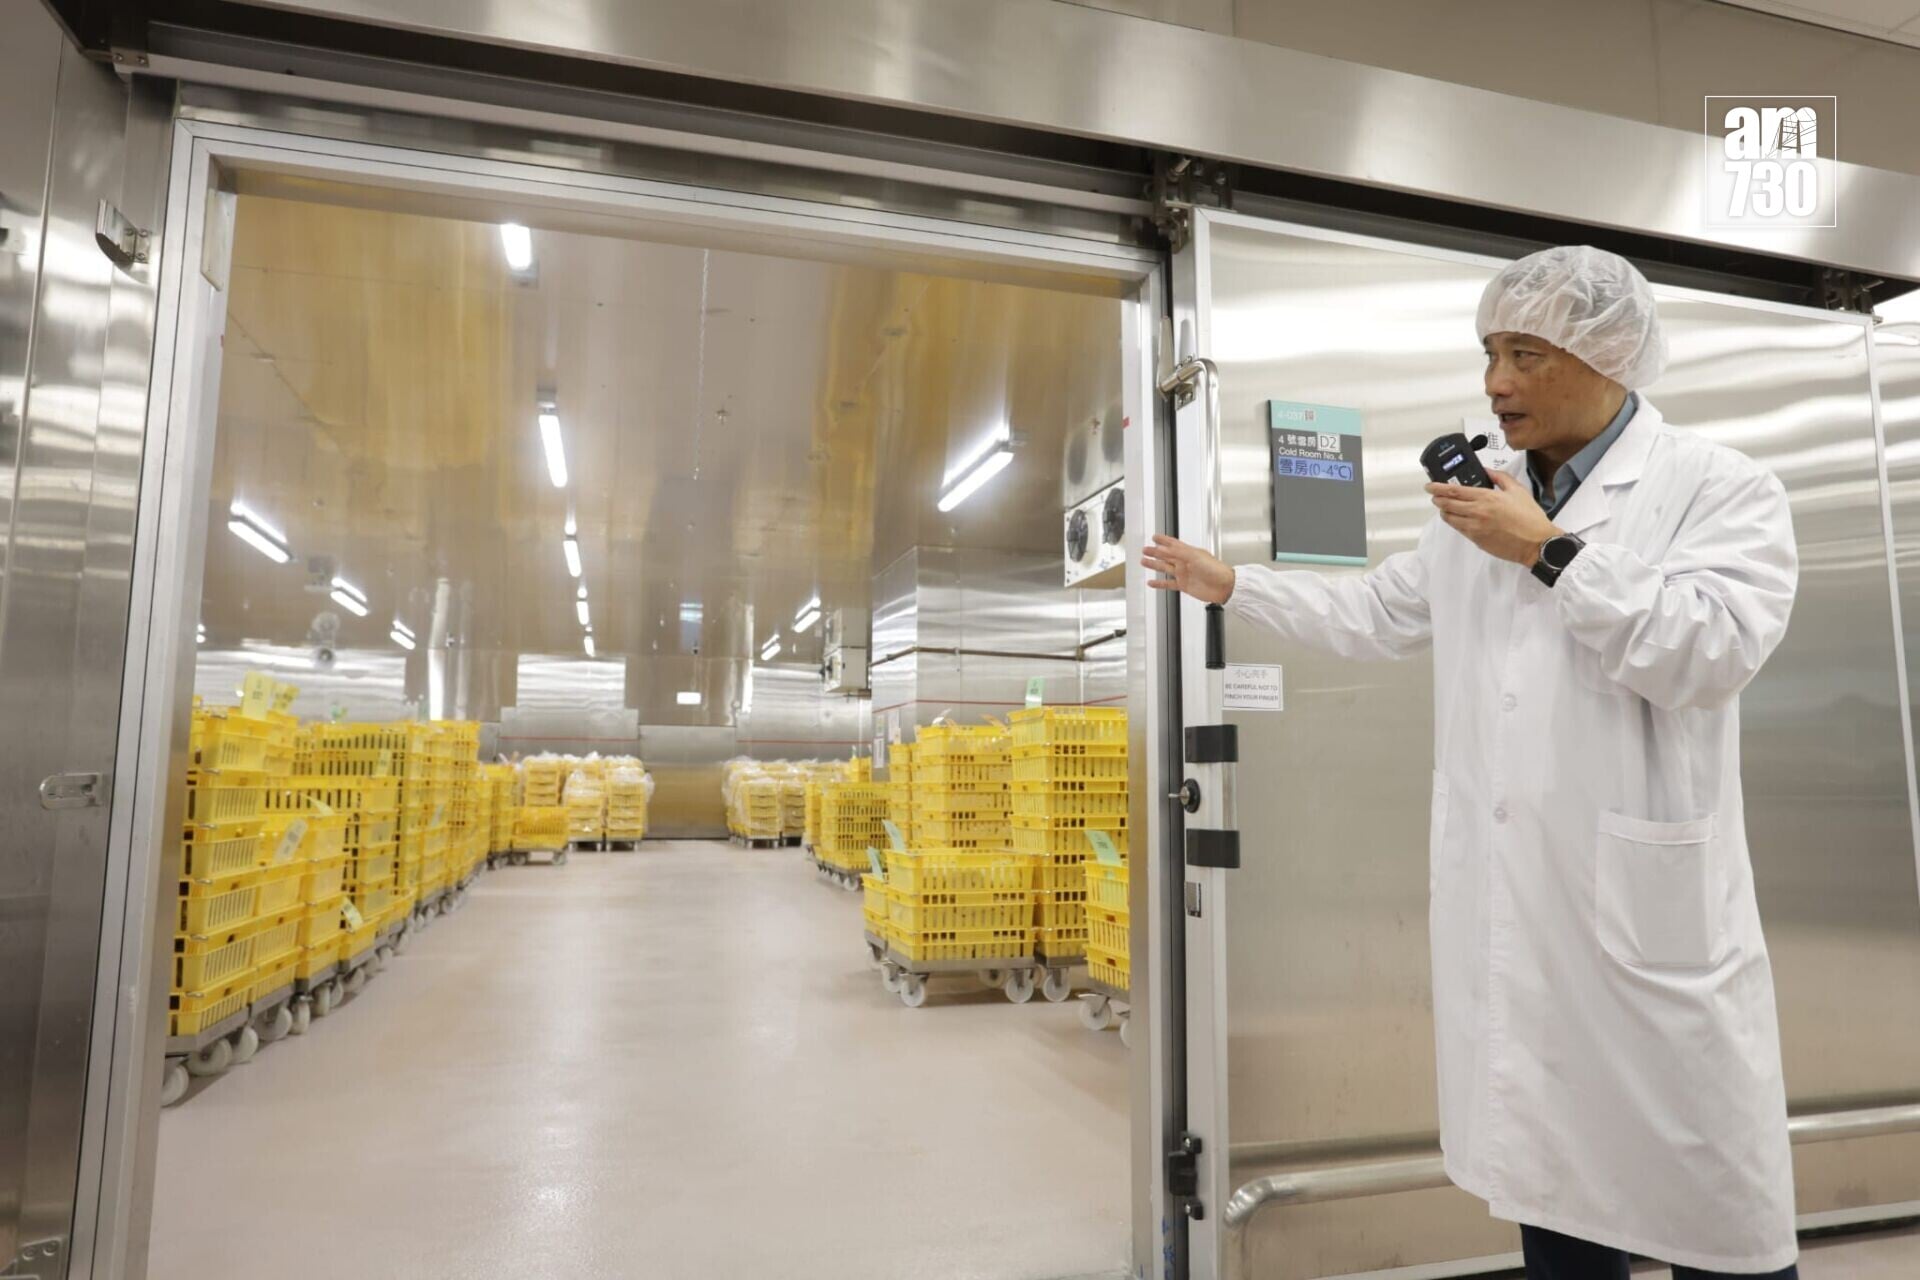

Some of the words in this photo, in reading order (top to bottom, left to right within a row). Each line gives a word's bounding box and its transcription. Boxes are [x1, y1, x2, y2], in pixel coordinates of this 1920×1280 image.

[1320, 435, 1337, 449] D2
[1279, 447, 1297, 456] Cold
[1299, 449, 1322, 459] Room
